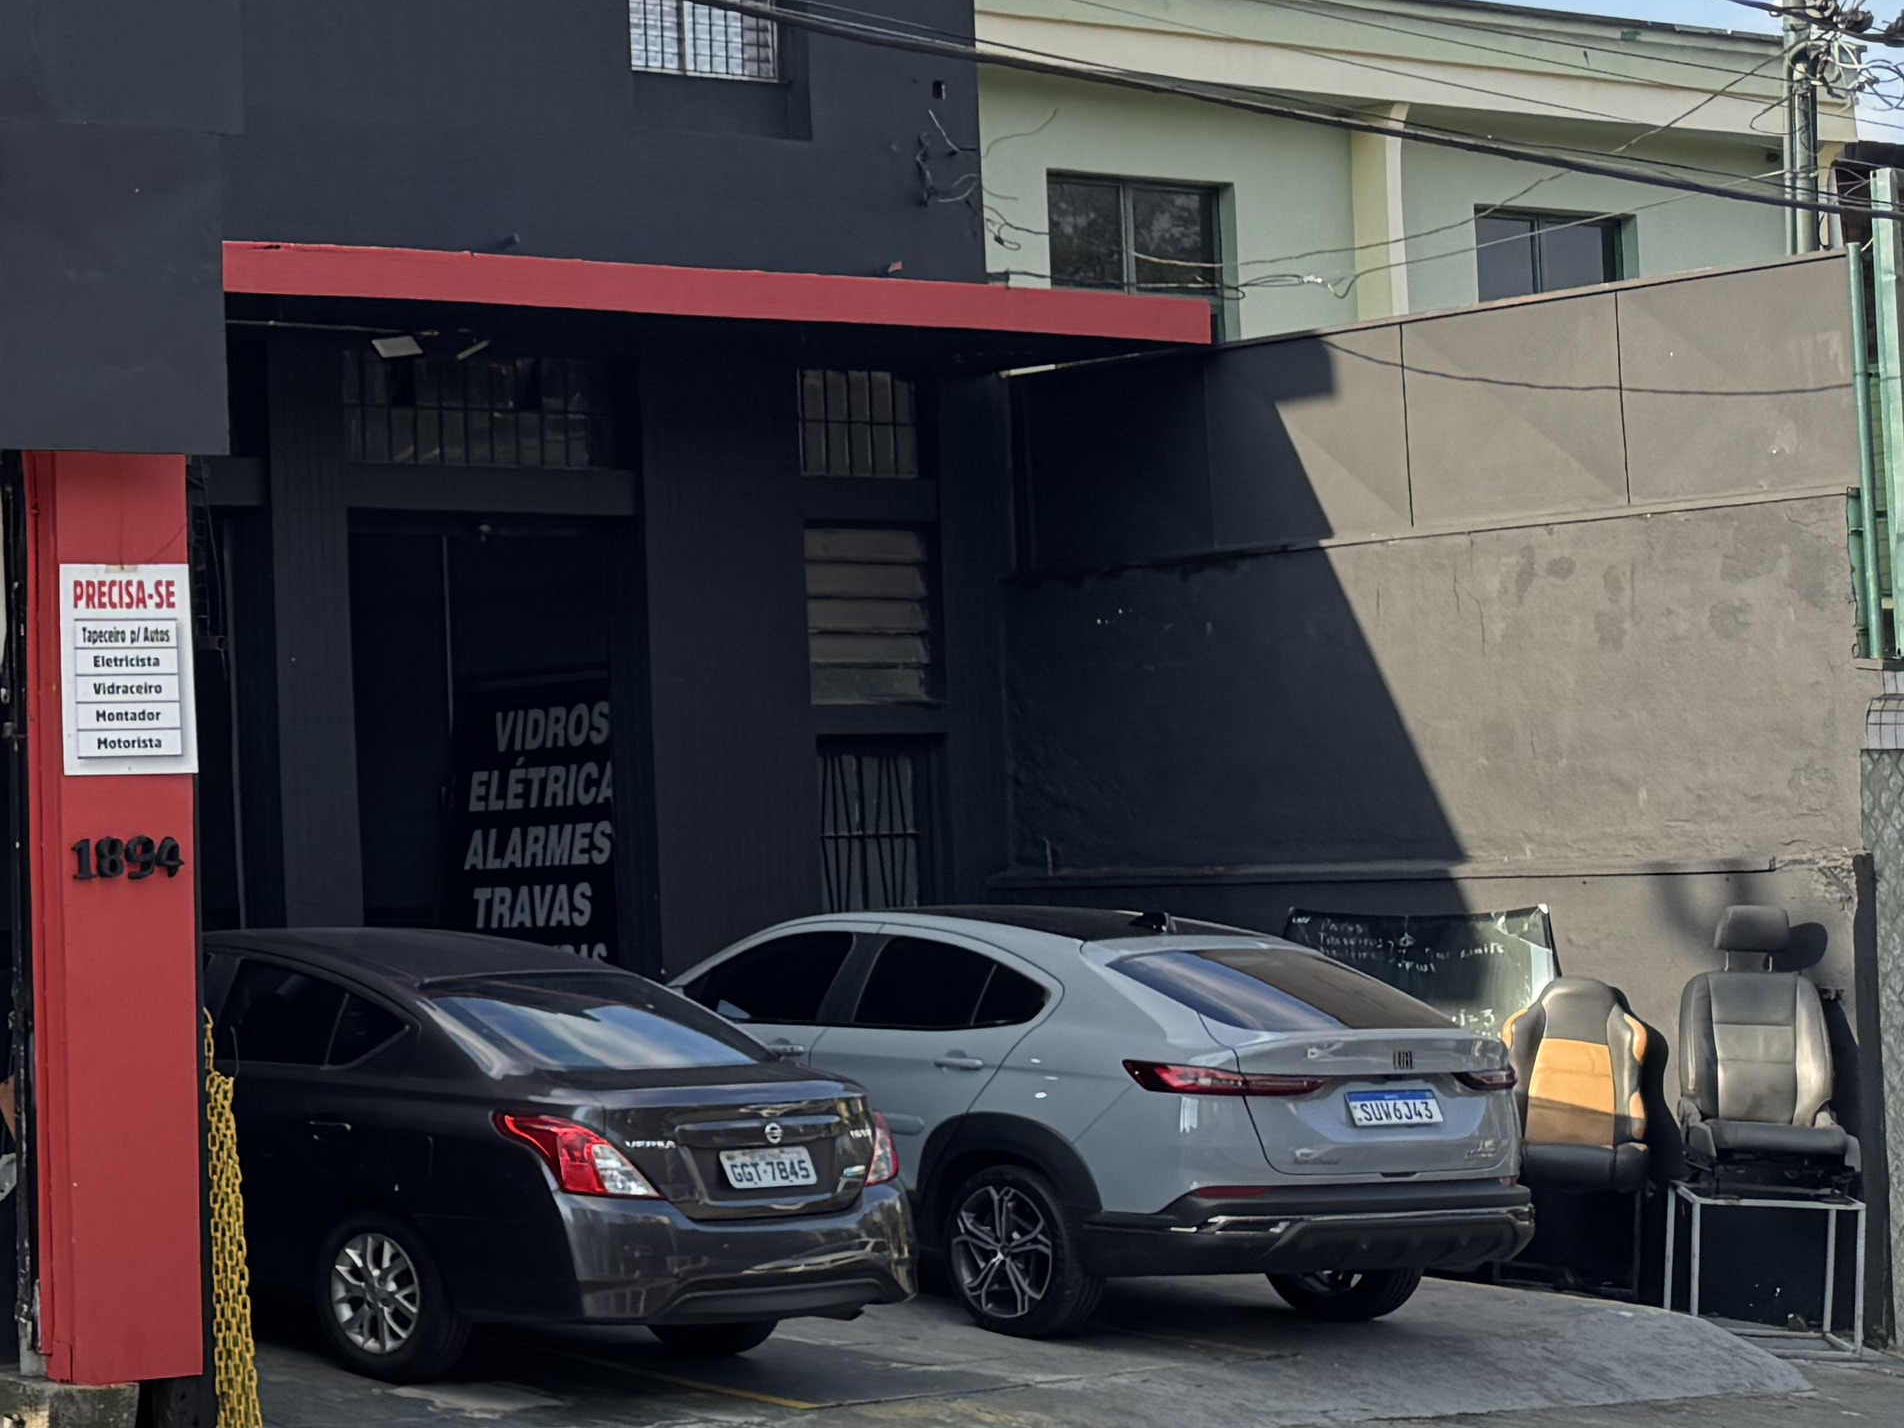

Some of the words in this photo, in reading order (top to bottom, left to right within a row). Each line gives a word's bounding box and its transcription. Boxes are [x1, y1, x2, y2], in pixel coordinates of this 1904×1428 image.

[74, 580, 175, 609] PRECISA-SE
[82, 627, 125, 644] Tapeceiro
[131, 627, 140, 644] p/
[144, 627, 169, 642] Autos
[94, 656, 159, 667] Eletricista
[94, 683, 162, 694] Vidraceiro
[96, 710, 160, 722] Montador
[496, 701, 609, 752] VIDROS
[98, 738, 161, 749] Motorista
[464, 821, 612, 869] ALARMES
[71, 836, 184, 881] 1894
[474, 882, 592, 928] TRAVAS
[1360, 1101, 1433, 1121] SUW6J43
